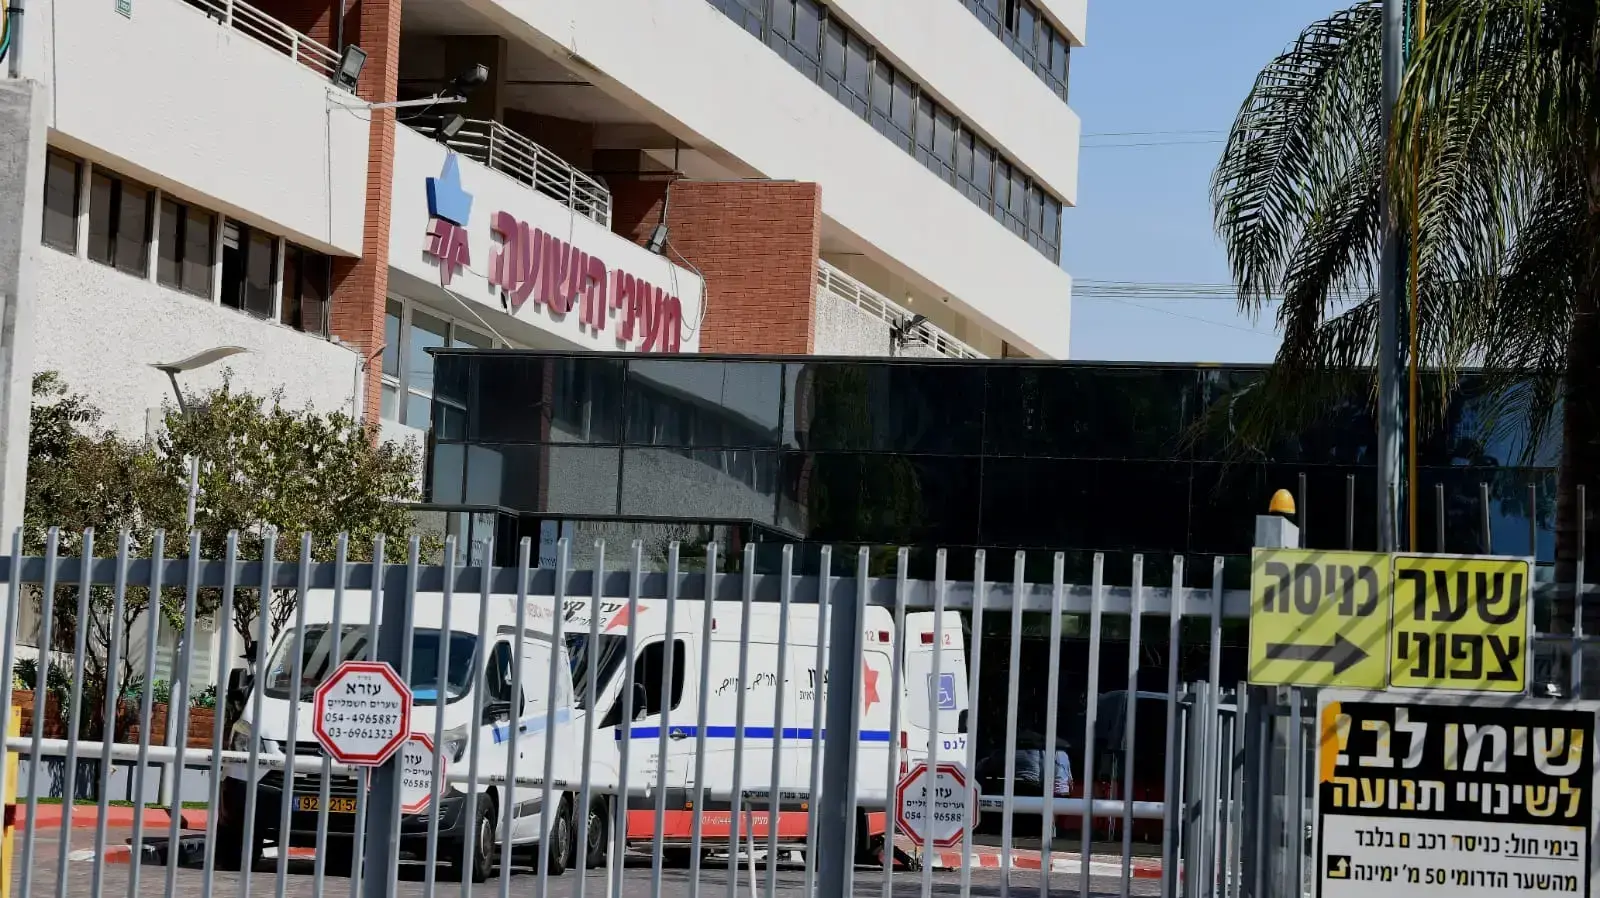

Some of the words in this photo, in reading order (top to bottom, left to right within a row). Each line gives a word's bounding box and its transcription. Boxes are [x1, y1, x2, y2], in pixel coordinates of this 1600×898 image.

[488, 210, 607, 331] הישועה
[1263, 561, 1379, 617] כניסה
[1397, 568, 1523, 625] שער
[1397, 631, 1521, 682] צפוני
[346, 682, 381, 696] עזרא
[327, 699, 367, 709] חשמליים
[369, 700, 399, 709] שערים
[325, 712, 398, 725] 054-4965887
[328, 727, 394, 740] 03-6961323
[1335, 707, 1428, 770] לב!
[404, 754, 422, 766] עזר
[1444, 723, 1584, 777] שימו
[1332, 776, 1446, 812] תנועה
[1455, 778, 1582, 818] לשינויי
[905, 811, 965, 822] 054-96588
[1354, 826, 1394, 848] בלבד
[1505, 833, 1539, 855] חול:
[1544, 839, 1579, 857] בימי
[1354, 864, 1398, 882] ימינה
[1424, 868, 1446, 885] 50
[1450, 868, 1508, 888] הדרומי
[1512, 872, 1578, 892] מהשער
